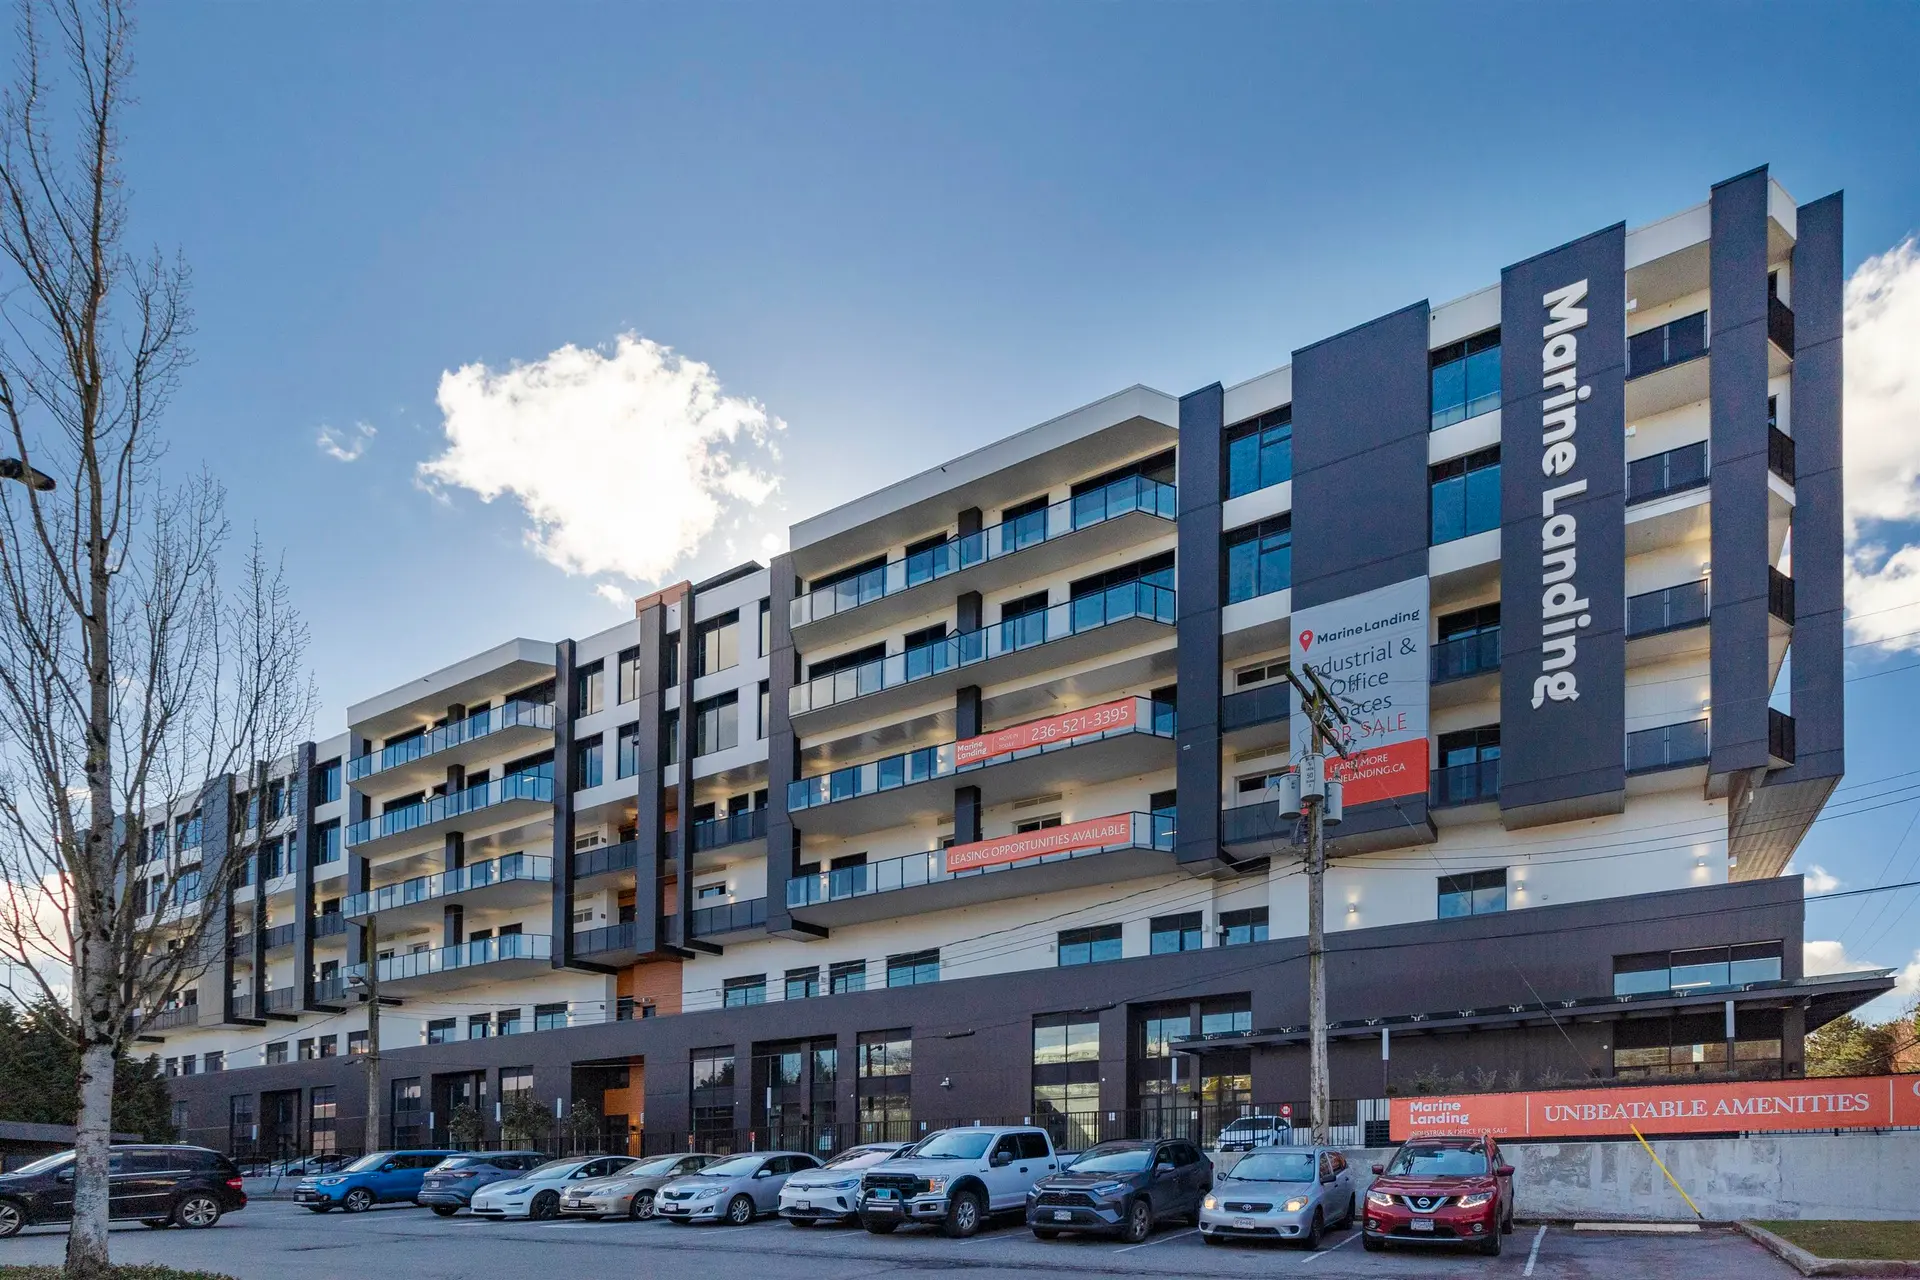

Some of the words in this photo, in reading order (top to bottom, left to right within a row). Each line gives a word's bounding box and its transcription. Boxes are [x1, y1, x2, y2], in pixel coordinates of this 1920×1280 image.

[1542, 278, 1592, 478] Marine
[1531, 478, 1592, 710] Landing
[1305, 641, 1393, 679] ndustrial
[1400, 637, 1417, 656] &
[1329, 671, 1389, 697] Office
[1031, 705, 1129, 742] 236-521-3395
[1322, 725, 1352, 746] OR
[1361, 712, 1407, 738] SALE
[957, 741, 984, 753] Marine
[957, 747, 987, 760] Landing
[950, 847, 989, 865] LEASING
[991, 833, 1070, 857] OPPORTUNITIES
[1071, 823, 1127, 842] AVAILABLE
[1410, 1099, 1462, 1113] Marine
[1410, 1112, 1470, 1126] Landing
[1544, 1100, 1708, 1122] UNBEATABLE
[1712, 1093, 1870, 1116] AMENITIES
[1492, 1126, 1508, 1135] SALE
